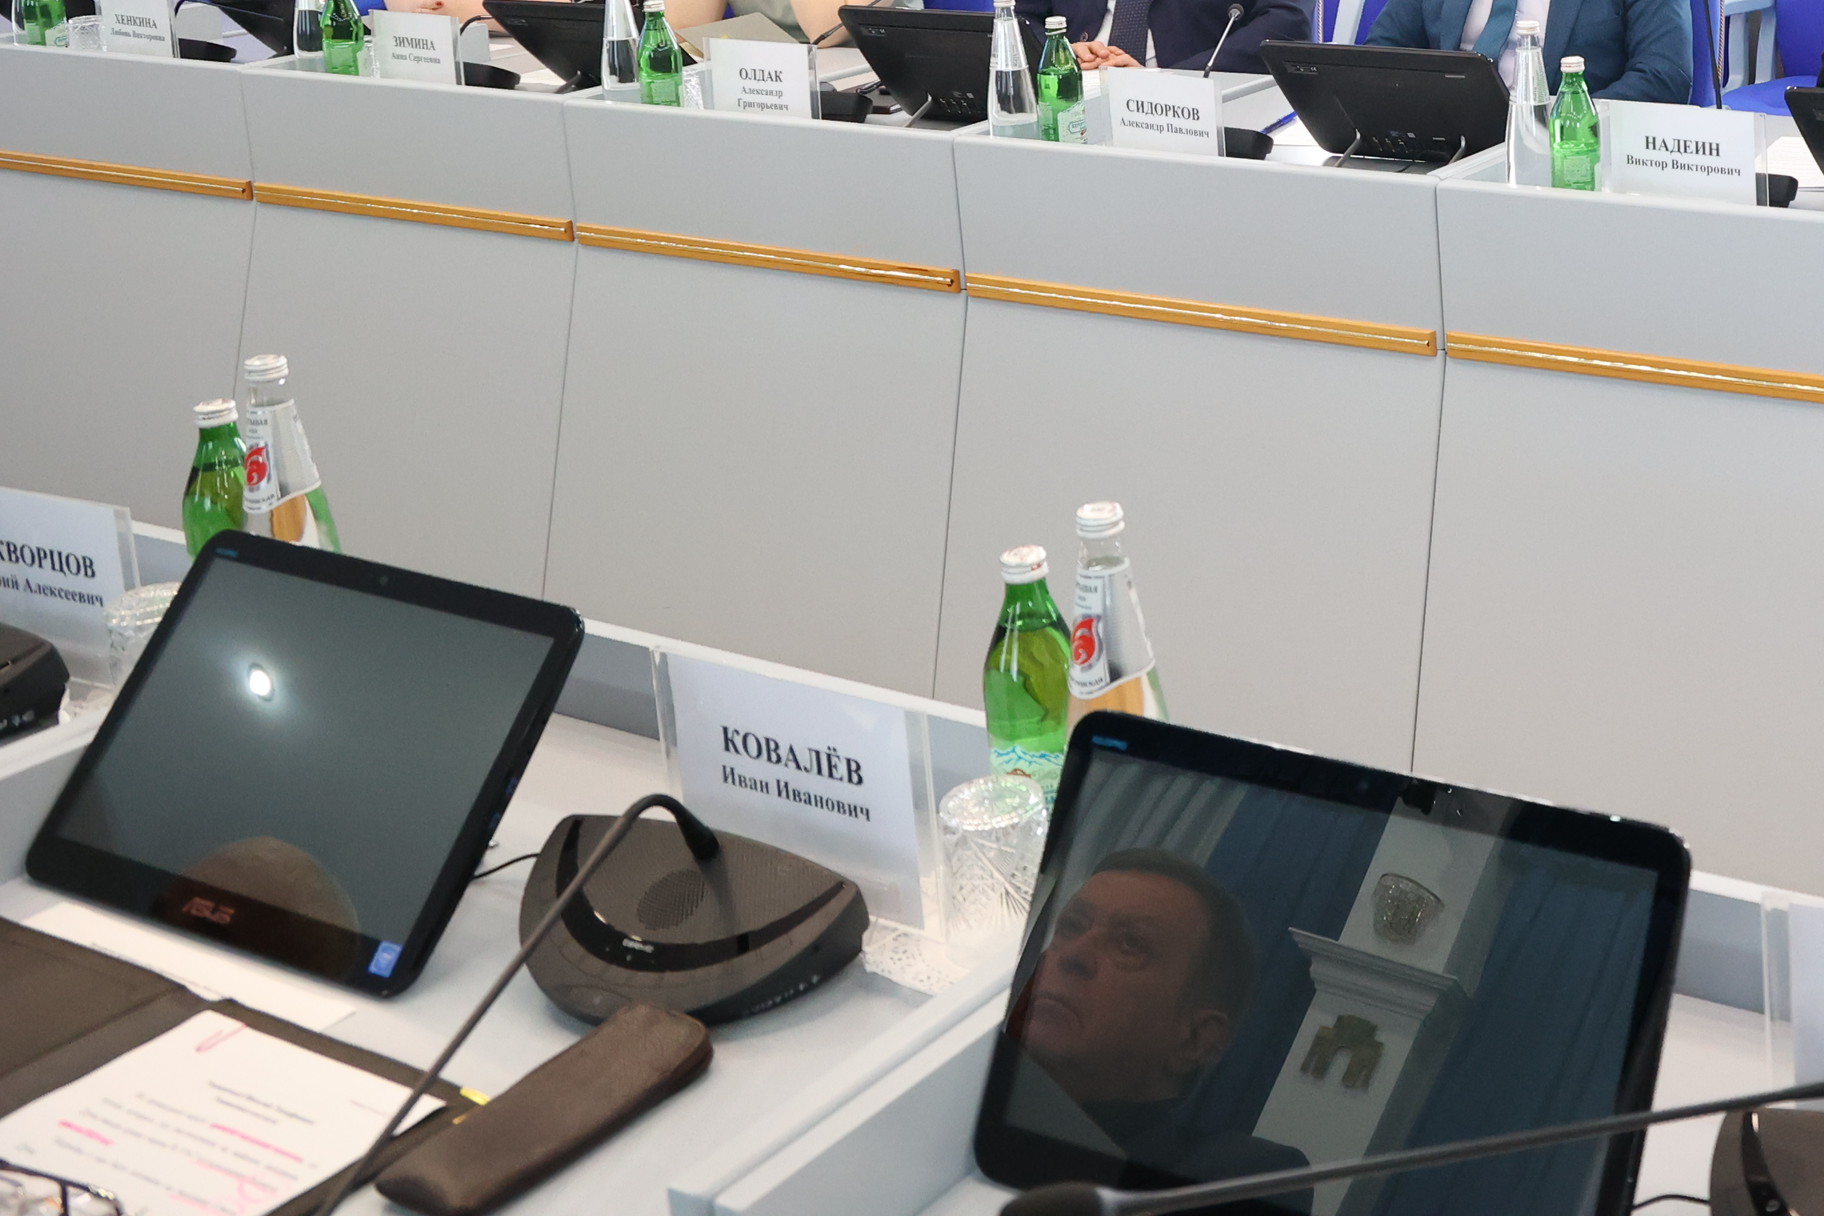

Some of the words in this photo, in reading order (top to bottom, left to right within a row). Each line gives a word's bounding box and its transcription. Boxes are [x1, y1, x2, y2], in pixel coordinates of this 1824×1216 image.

[114, 13, 158, 29] ХЕНКИНА
[392, 35, 436, 51] ЗИМИНА
[739, 67, 784, 83] ОЛДАК
[740, 85, 784, 99] Александр
[737, 98, 789, 112] Григорьевич
[1126, 98, 1201, 121] СИДОРКОВ
[1120, 116, 1165, 135] Александр
[1166, 122, 1210, 139] Павлович
[1644, 135, 1721, 157] НАДЕИН
[1626, 154, 1668, 171] Виктор
[1671, 159, 1741, 177] Викторович
[23, 577, 104, 608] Алексеевич
[720, 725, 864, 786] КОВАЛЁВ
[721, 765, 770, 795] Иван
[776, 778, 871, 822] Иванович
